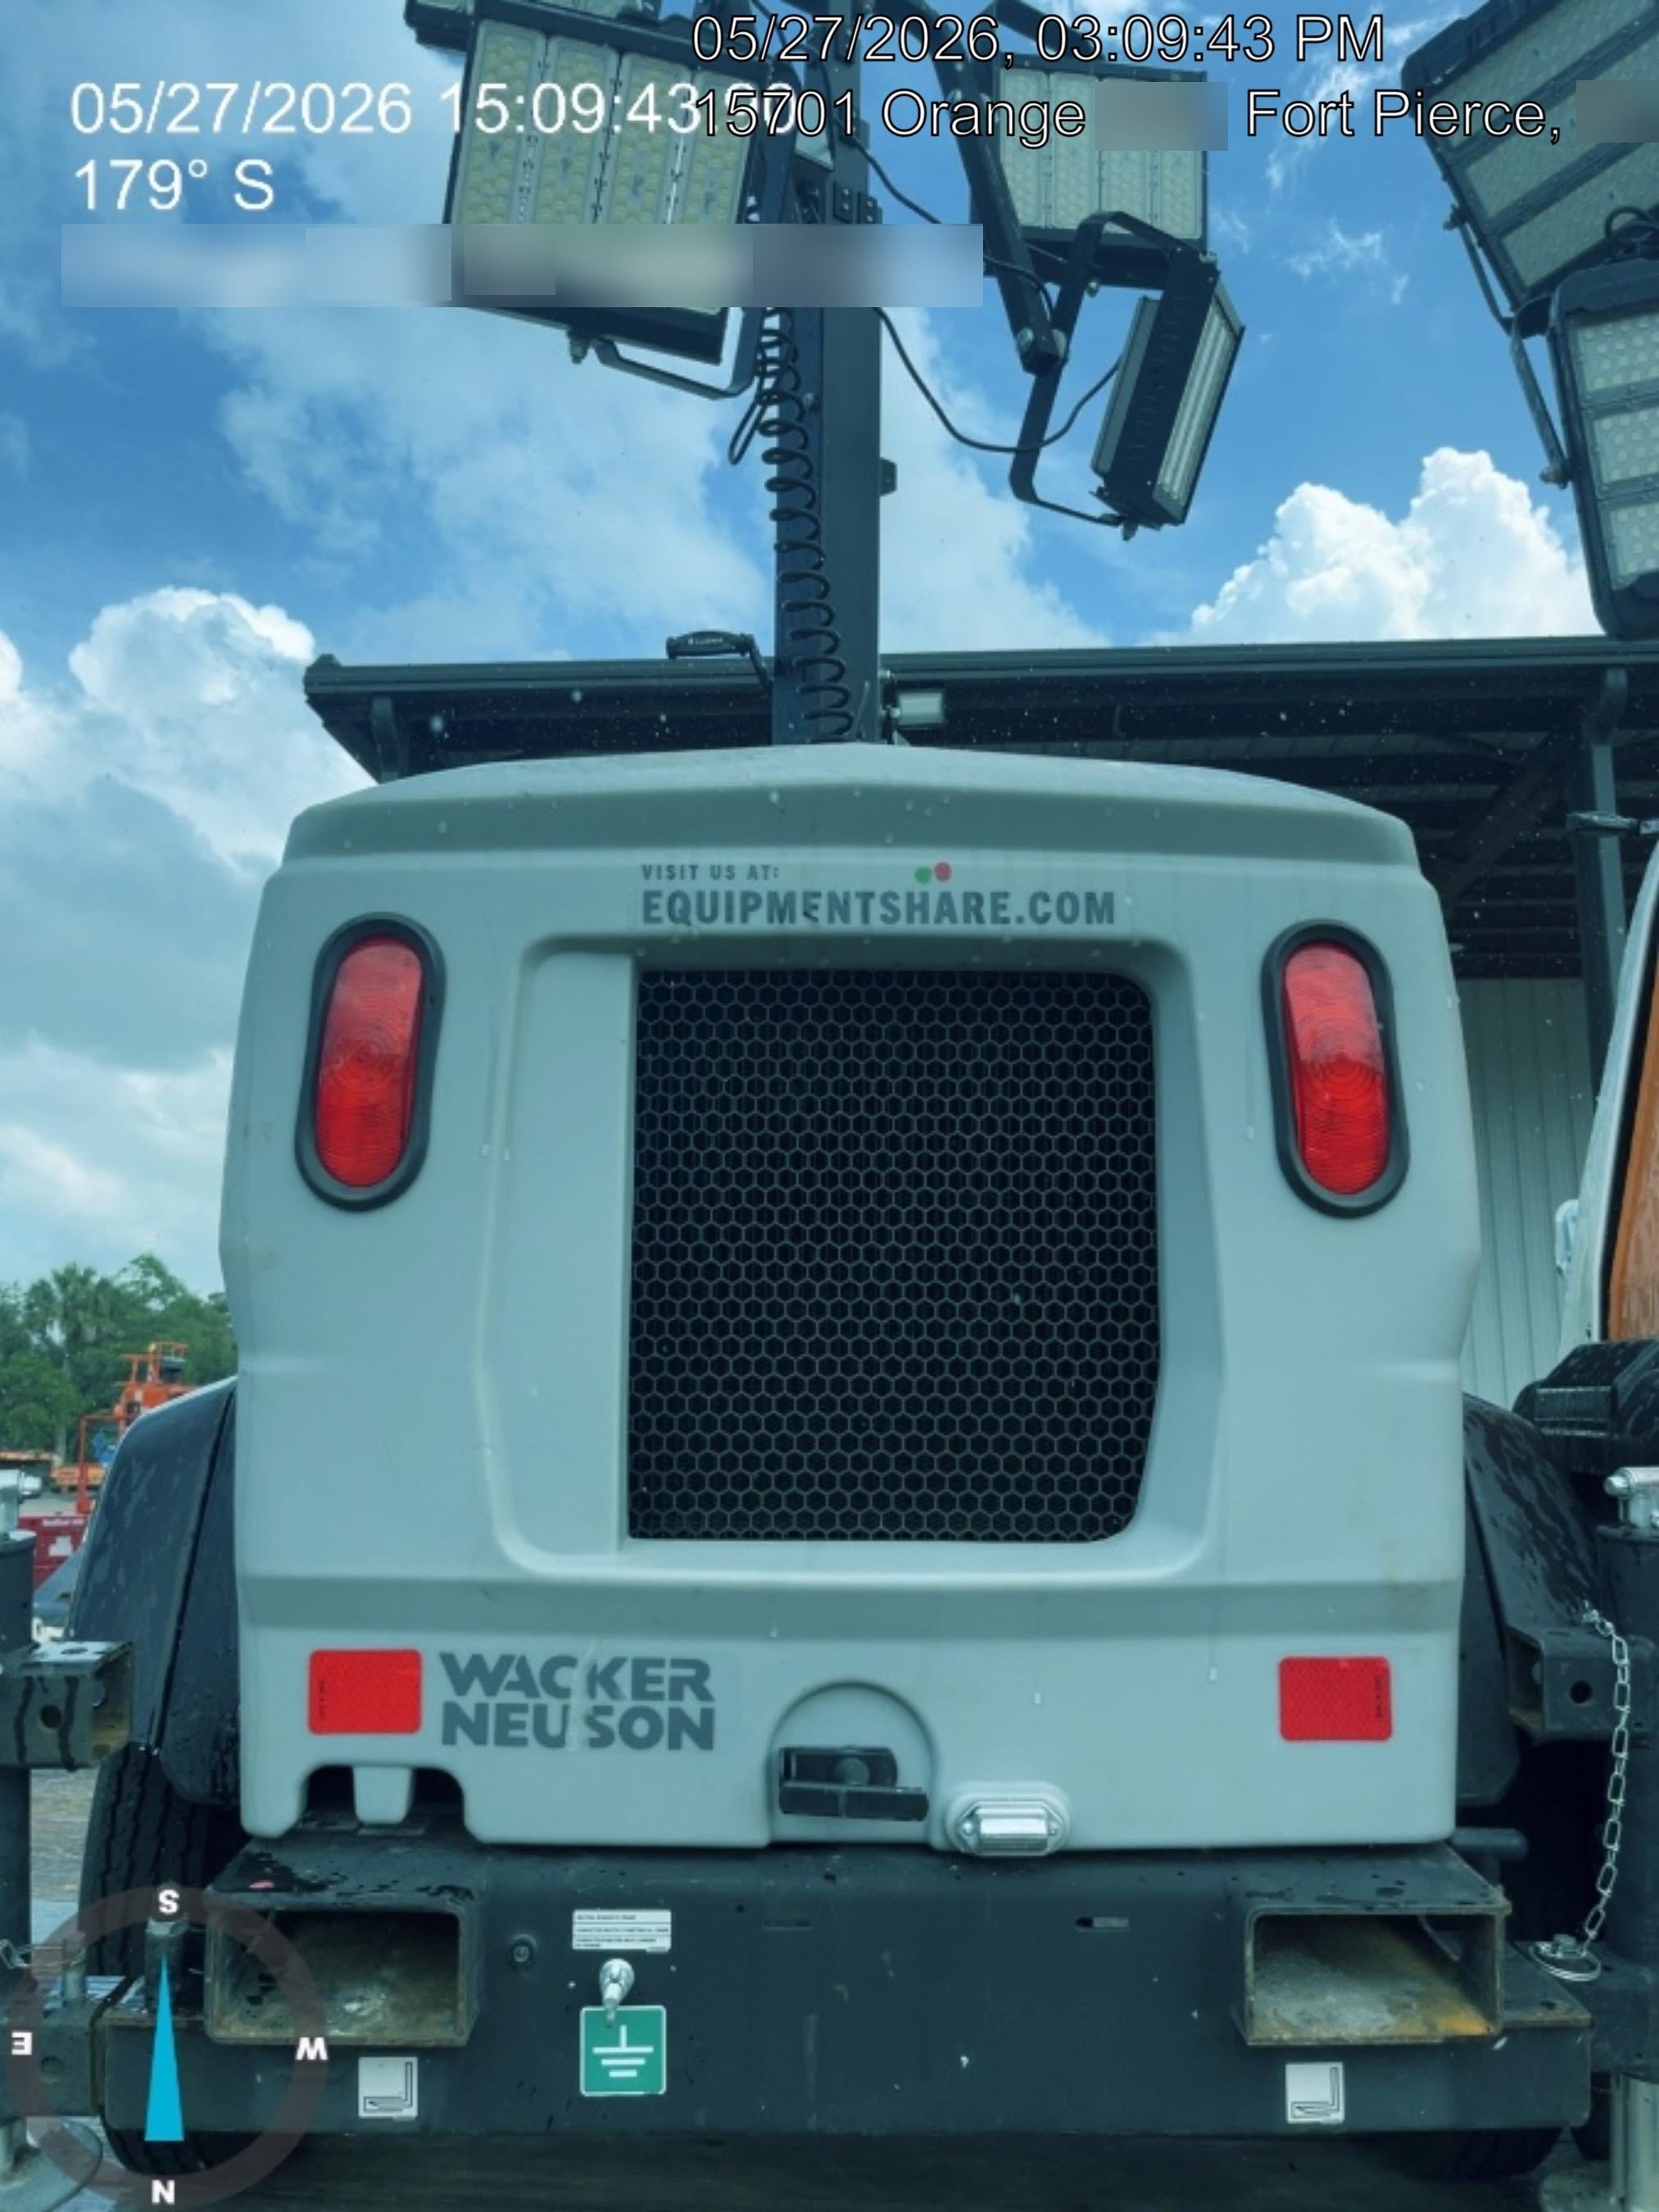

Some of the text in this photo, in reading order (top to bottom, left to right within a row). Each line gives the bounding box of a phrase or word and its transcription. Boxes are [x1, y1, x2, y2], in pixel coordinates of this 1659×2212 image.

[641, 864, 779, 881] VISIT US AT:
[642, 890, 1115, 927] EQUIPMENTSHARE.COM
[439, 1652, 715, 1702] WACKER
[441, 1702, 715, 1751] NEUSON
